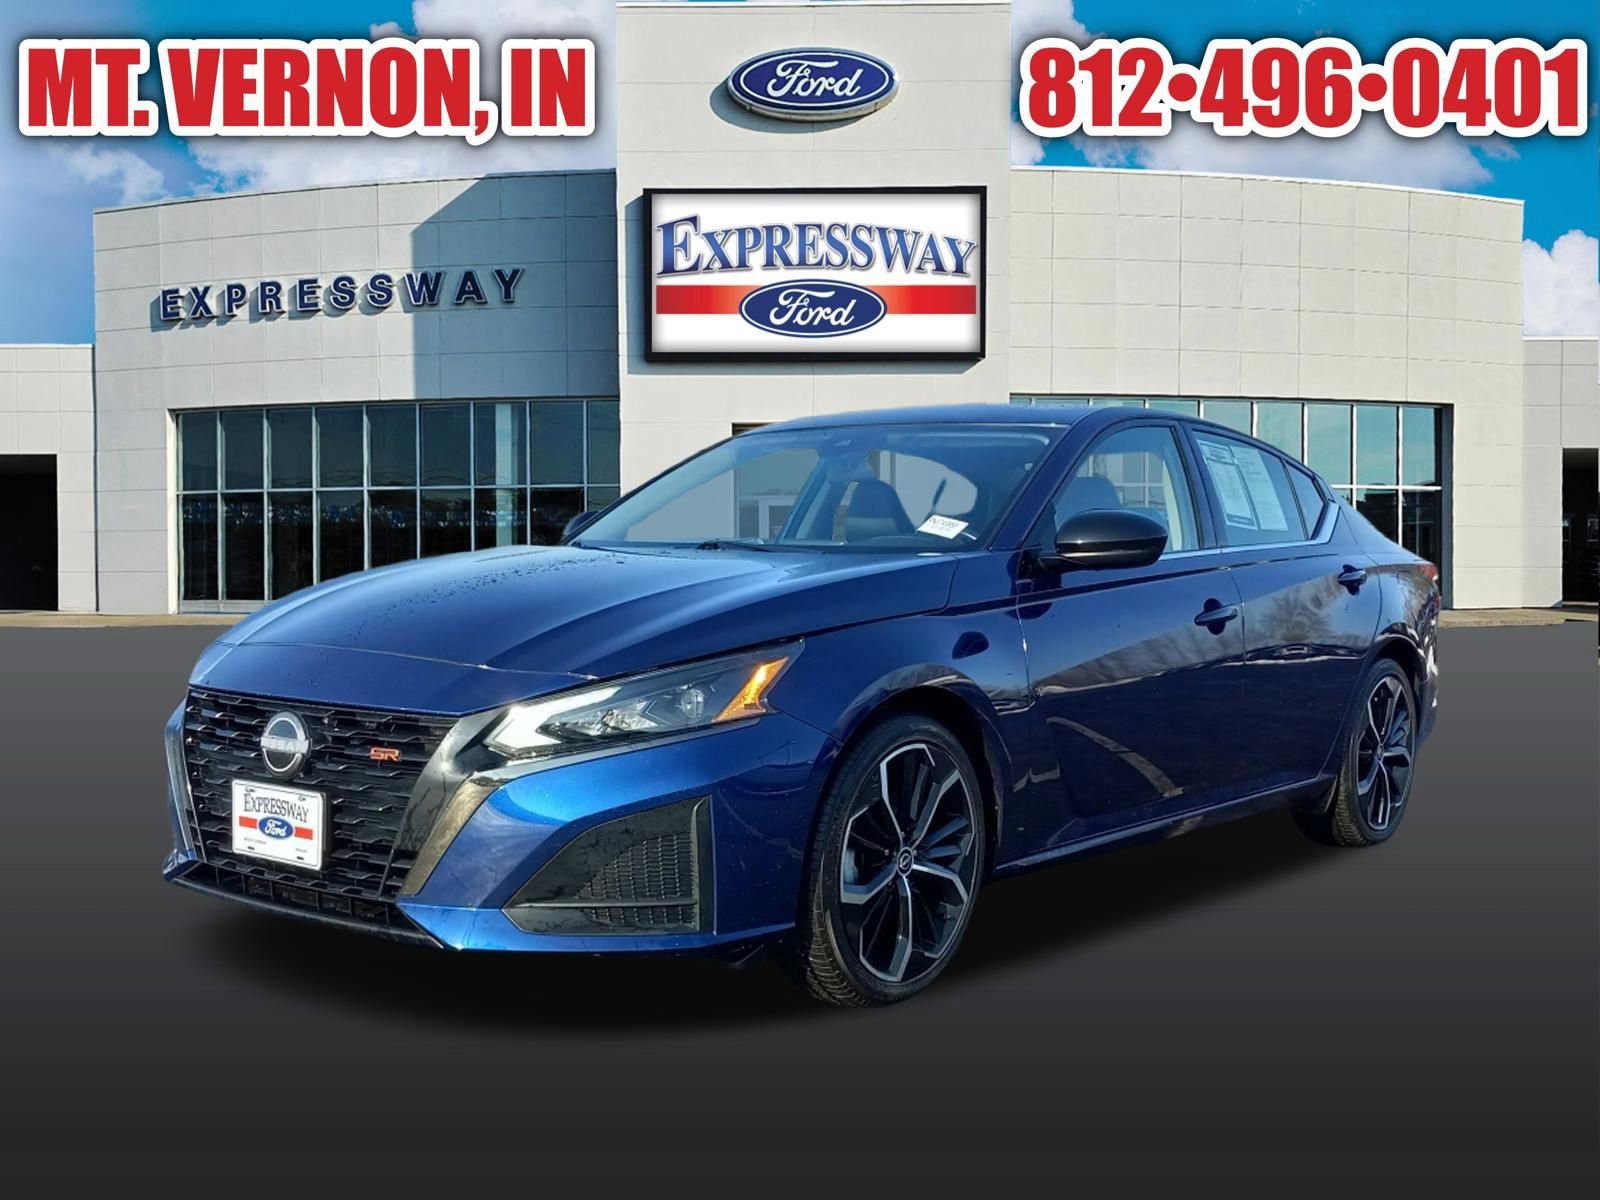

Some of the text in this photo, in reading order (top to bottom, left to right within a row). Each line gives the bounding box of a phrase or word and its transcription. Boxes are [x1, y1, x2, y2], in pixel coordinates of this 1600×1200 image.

[766, 60, 863, 97] Ford
[160, 269, 524, 321] EXPRESSWAY
[769, 288, 857, 327] Ford
[369, 747, 400, 761] SR
[264, 819, 288, 837] Ford
